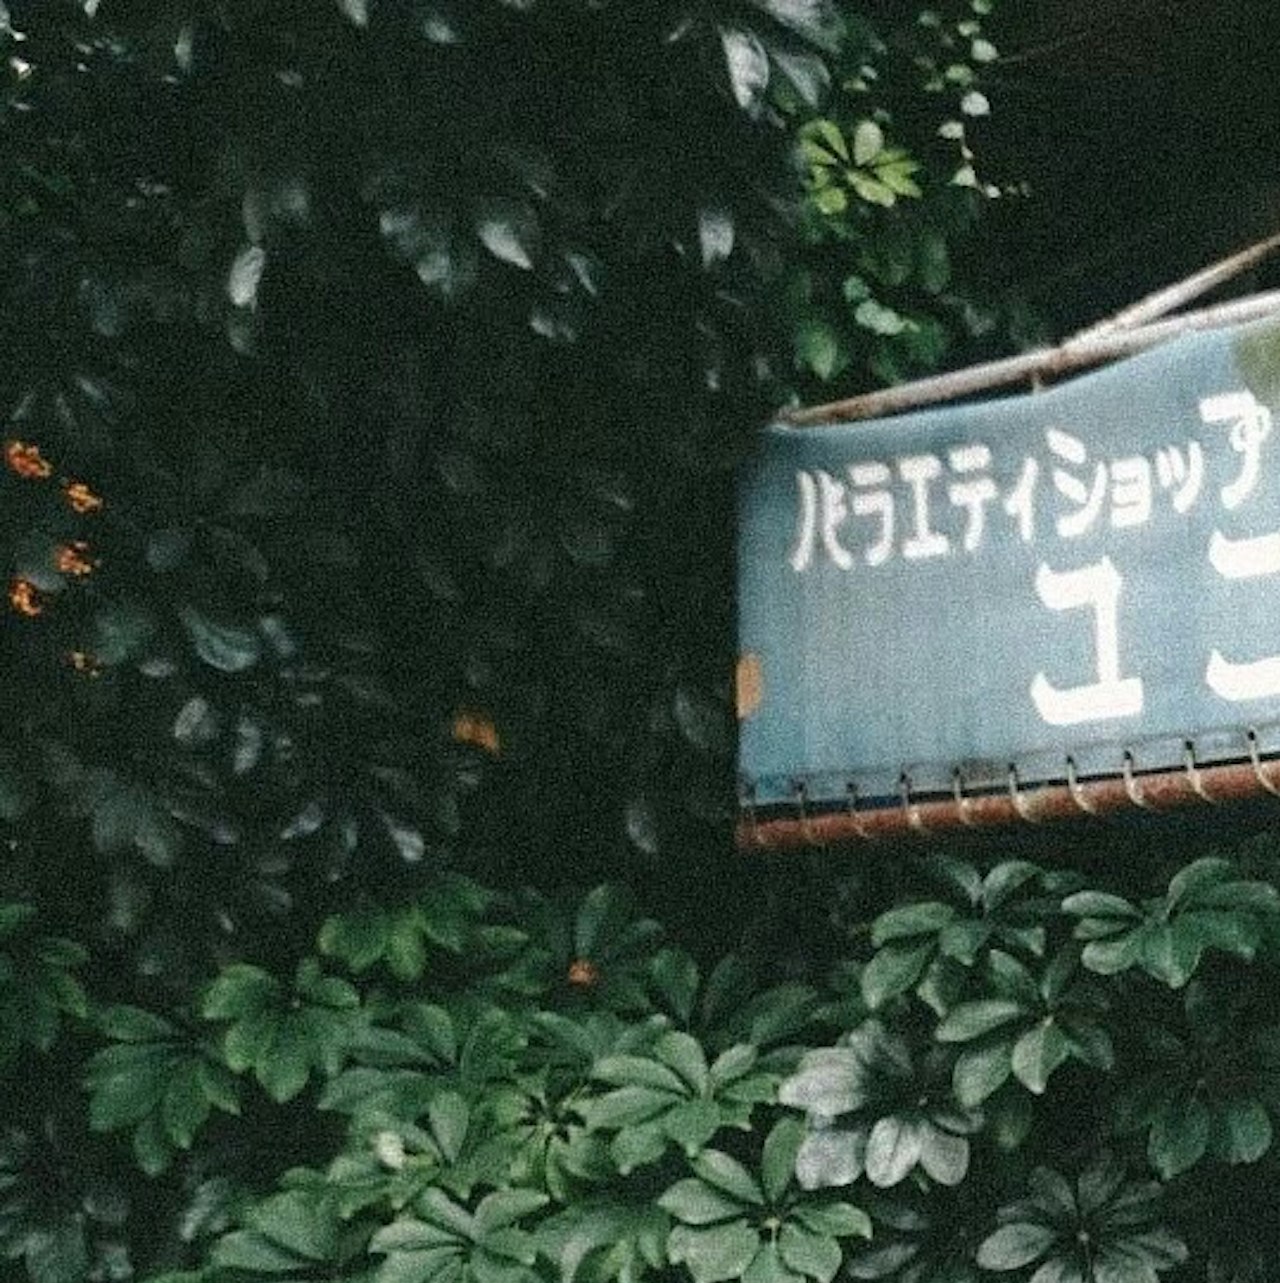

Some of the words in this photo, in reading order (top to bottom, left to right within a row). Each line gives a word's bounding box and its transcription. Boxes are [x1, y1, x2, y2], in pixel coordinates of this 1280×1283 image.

[789, 388, 1272, 571] バラエティショップ
